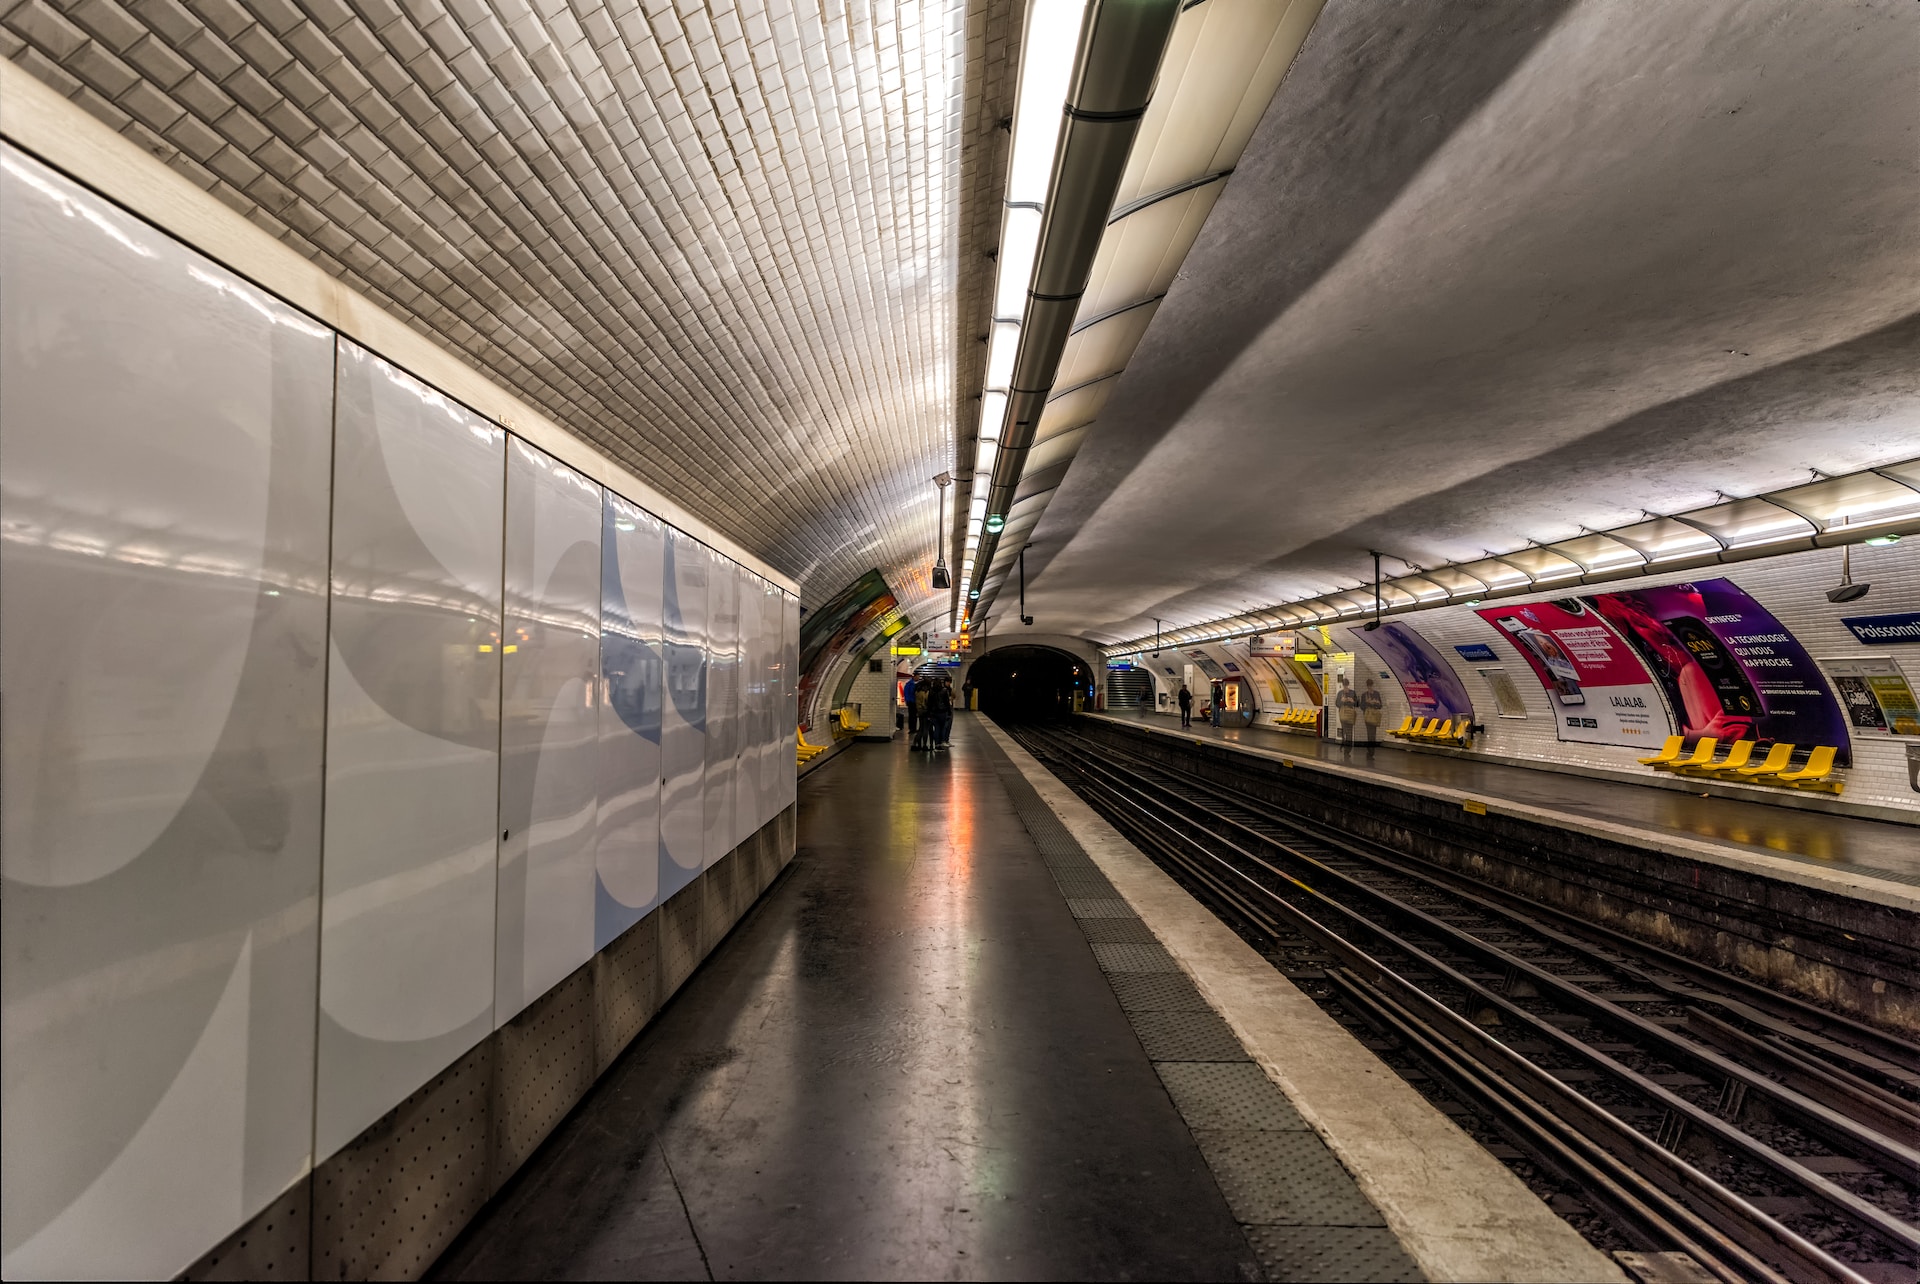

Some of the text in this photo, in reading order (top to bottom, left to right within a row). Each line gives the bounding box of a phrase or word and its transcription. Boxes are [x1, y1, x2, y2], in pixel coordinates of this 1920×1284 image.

[1585, 629, 1607, 638] photos
[1853, 621, 1920, 638] Poissonni
[1724, 633, 1789, 645] LA TECHNOLOGIE
[1687, 640, 1715, 653] SKYN
[1734, 646, 1775, 656] QUI NOUS
[1742, 657, 1793, 667] RAPPROCHE
[1609, 696, 1647, 708] LALALAB.
